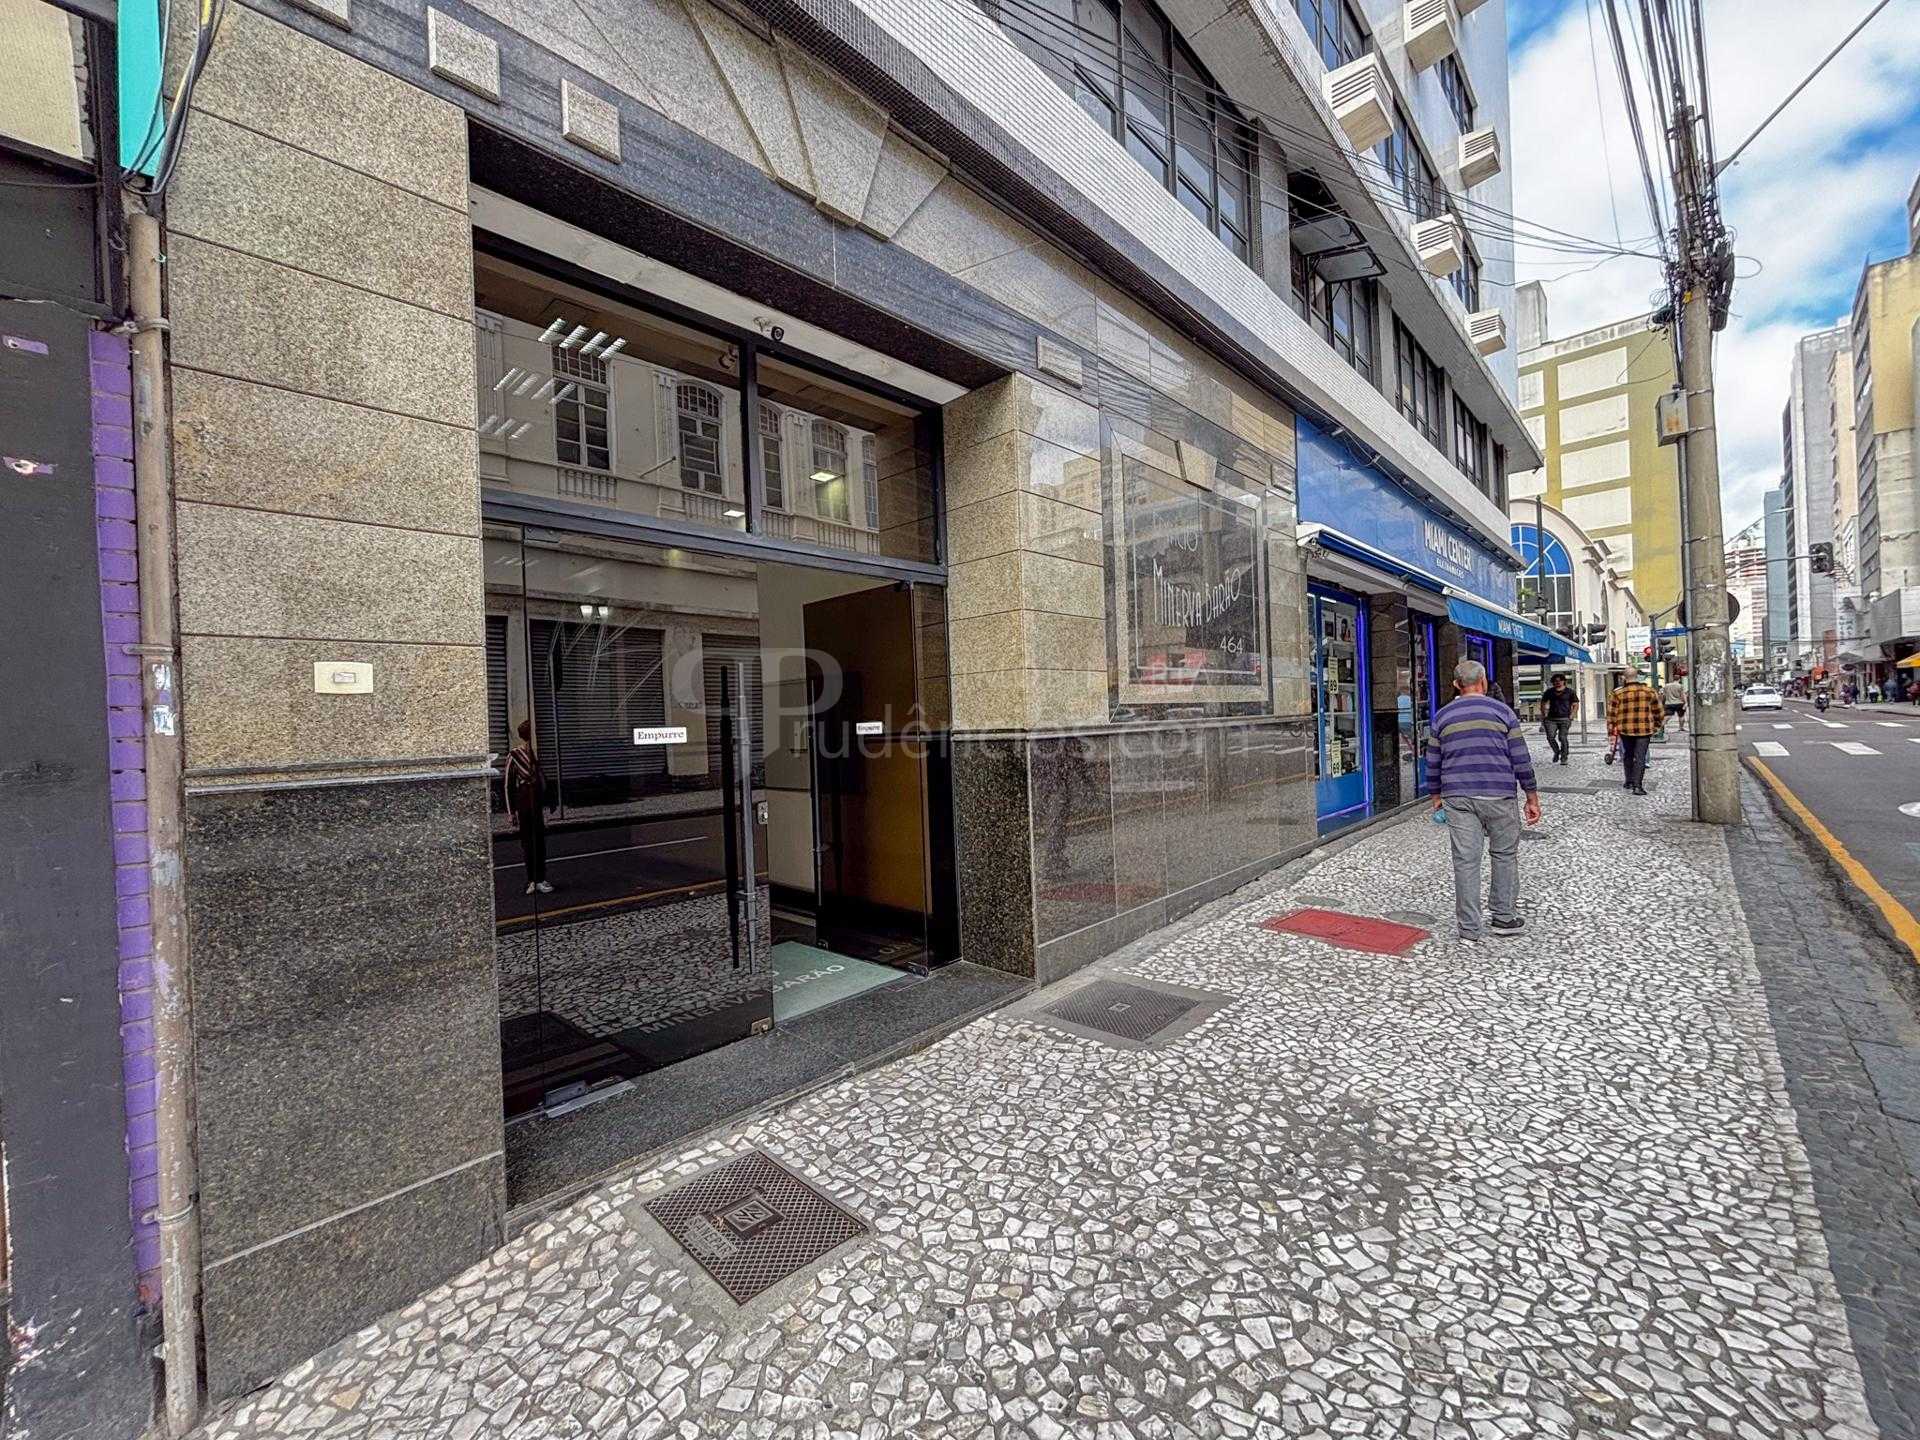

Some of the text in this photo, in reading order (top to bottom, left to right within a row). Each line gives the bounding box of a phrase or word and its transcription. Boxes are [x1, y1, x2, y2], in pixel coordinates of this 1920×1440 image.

[1423, 519, 1448, 559] MIAMI
[1448, 535, 1472, 572] CENTER
[1153, 558, 1241, 628] MINERVA BARÃO
[1219, 635, 1244, 654] 464
[637, 730, 685, 742] Empurre
